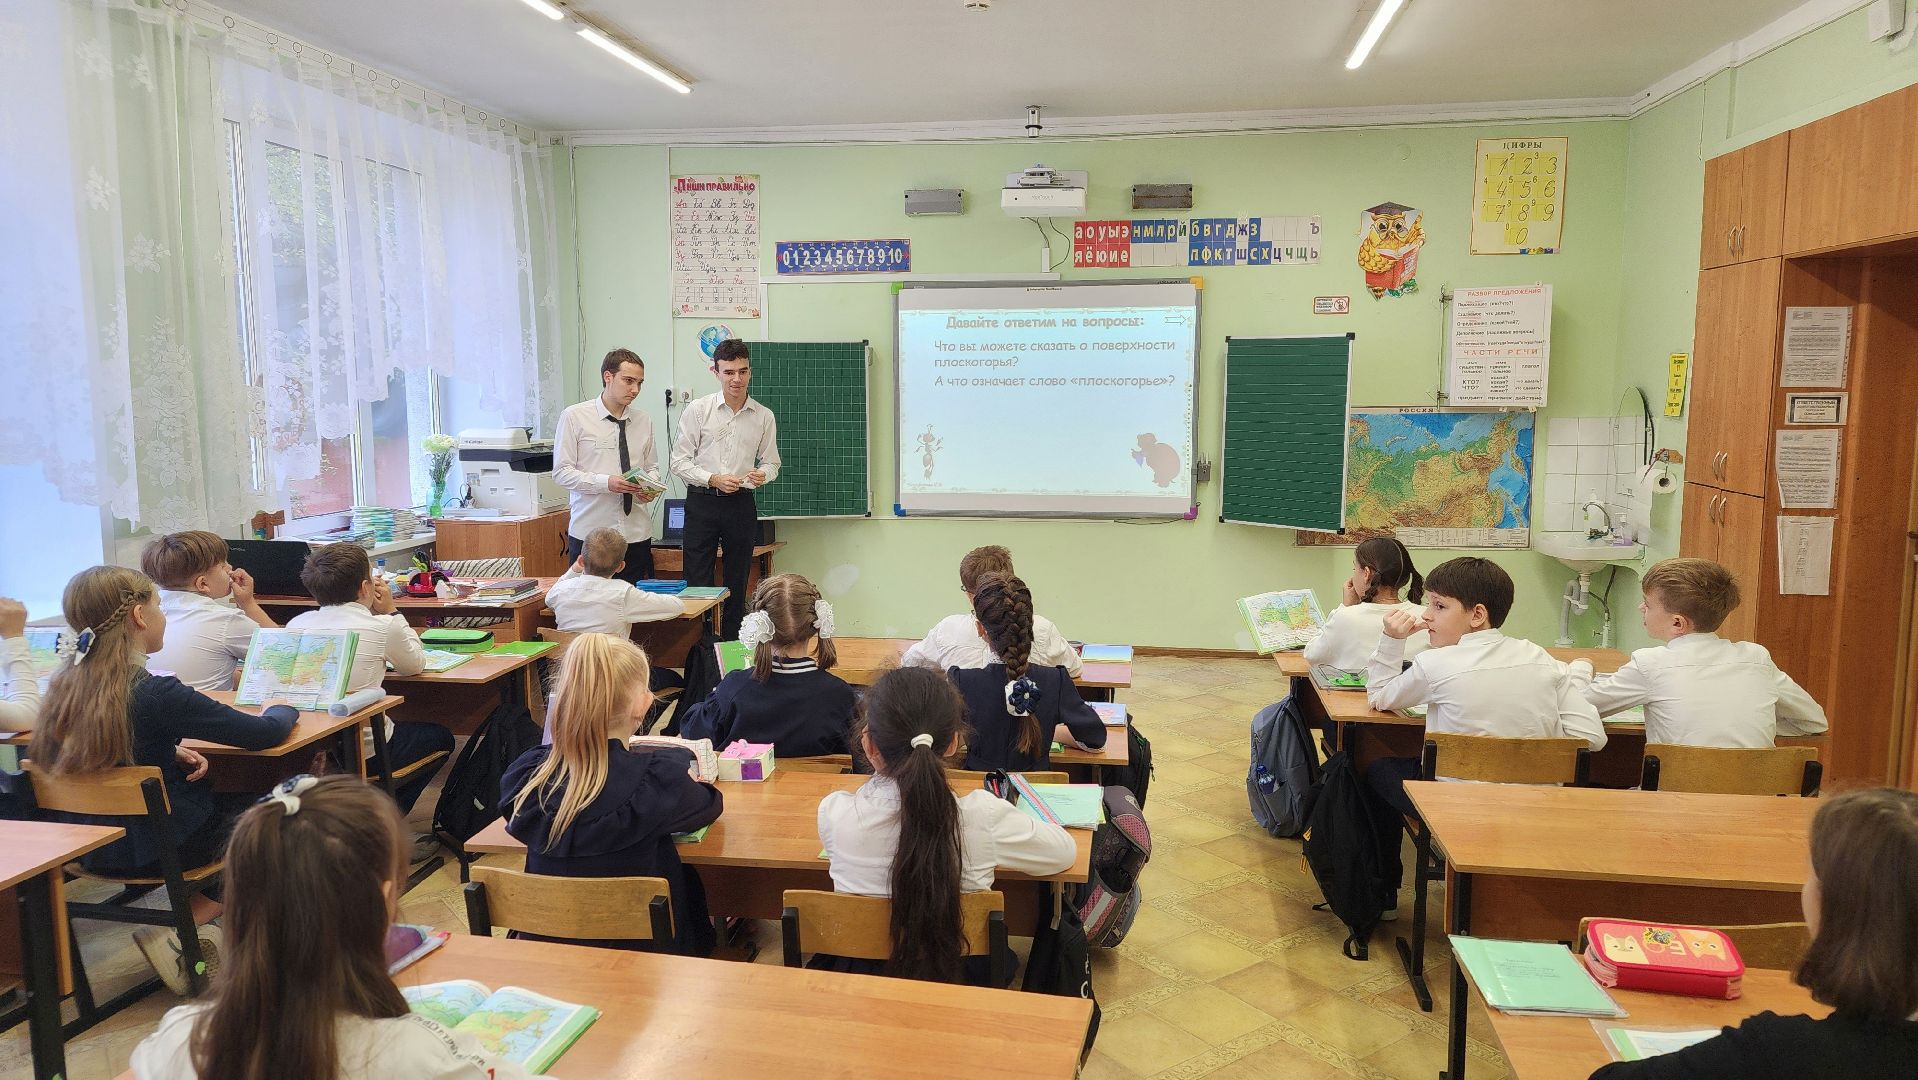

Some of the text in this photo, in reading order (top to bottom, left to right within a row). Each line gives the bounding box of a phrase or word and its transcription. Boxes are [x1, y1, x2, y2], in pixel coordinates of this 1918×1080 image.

[946, 317, 1144, 329] Давайте ответим на вопросы:
[934, 340, 1175, 352] Что вы можете сказать о поверхности
[934, 357, 1019, 370] плоскогорья?
[934, 375, 1175, 388] А что означает слово «плоскогорье»?
